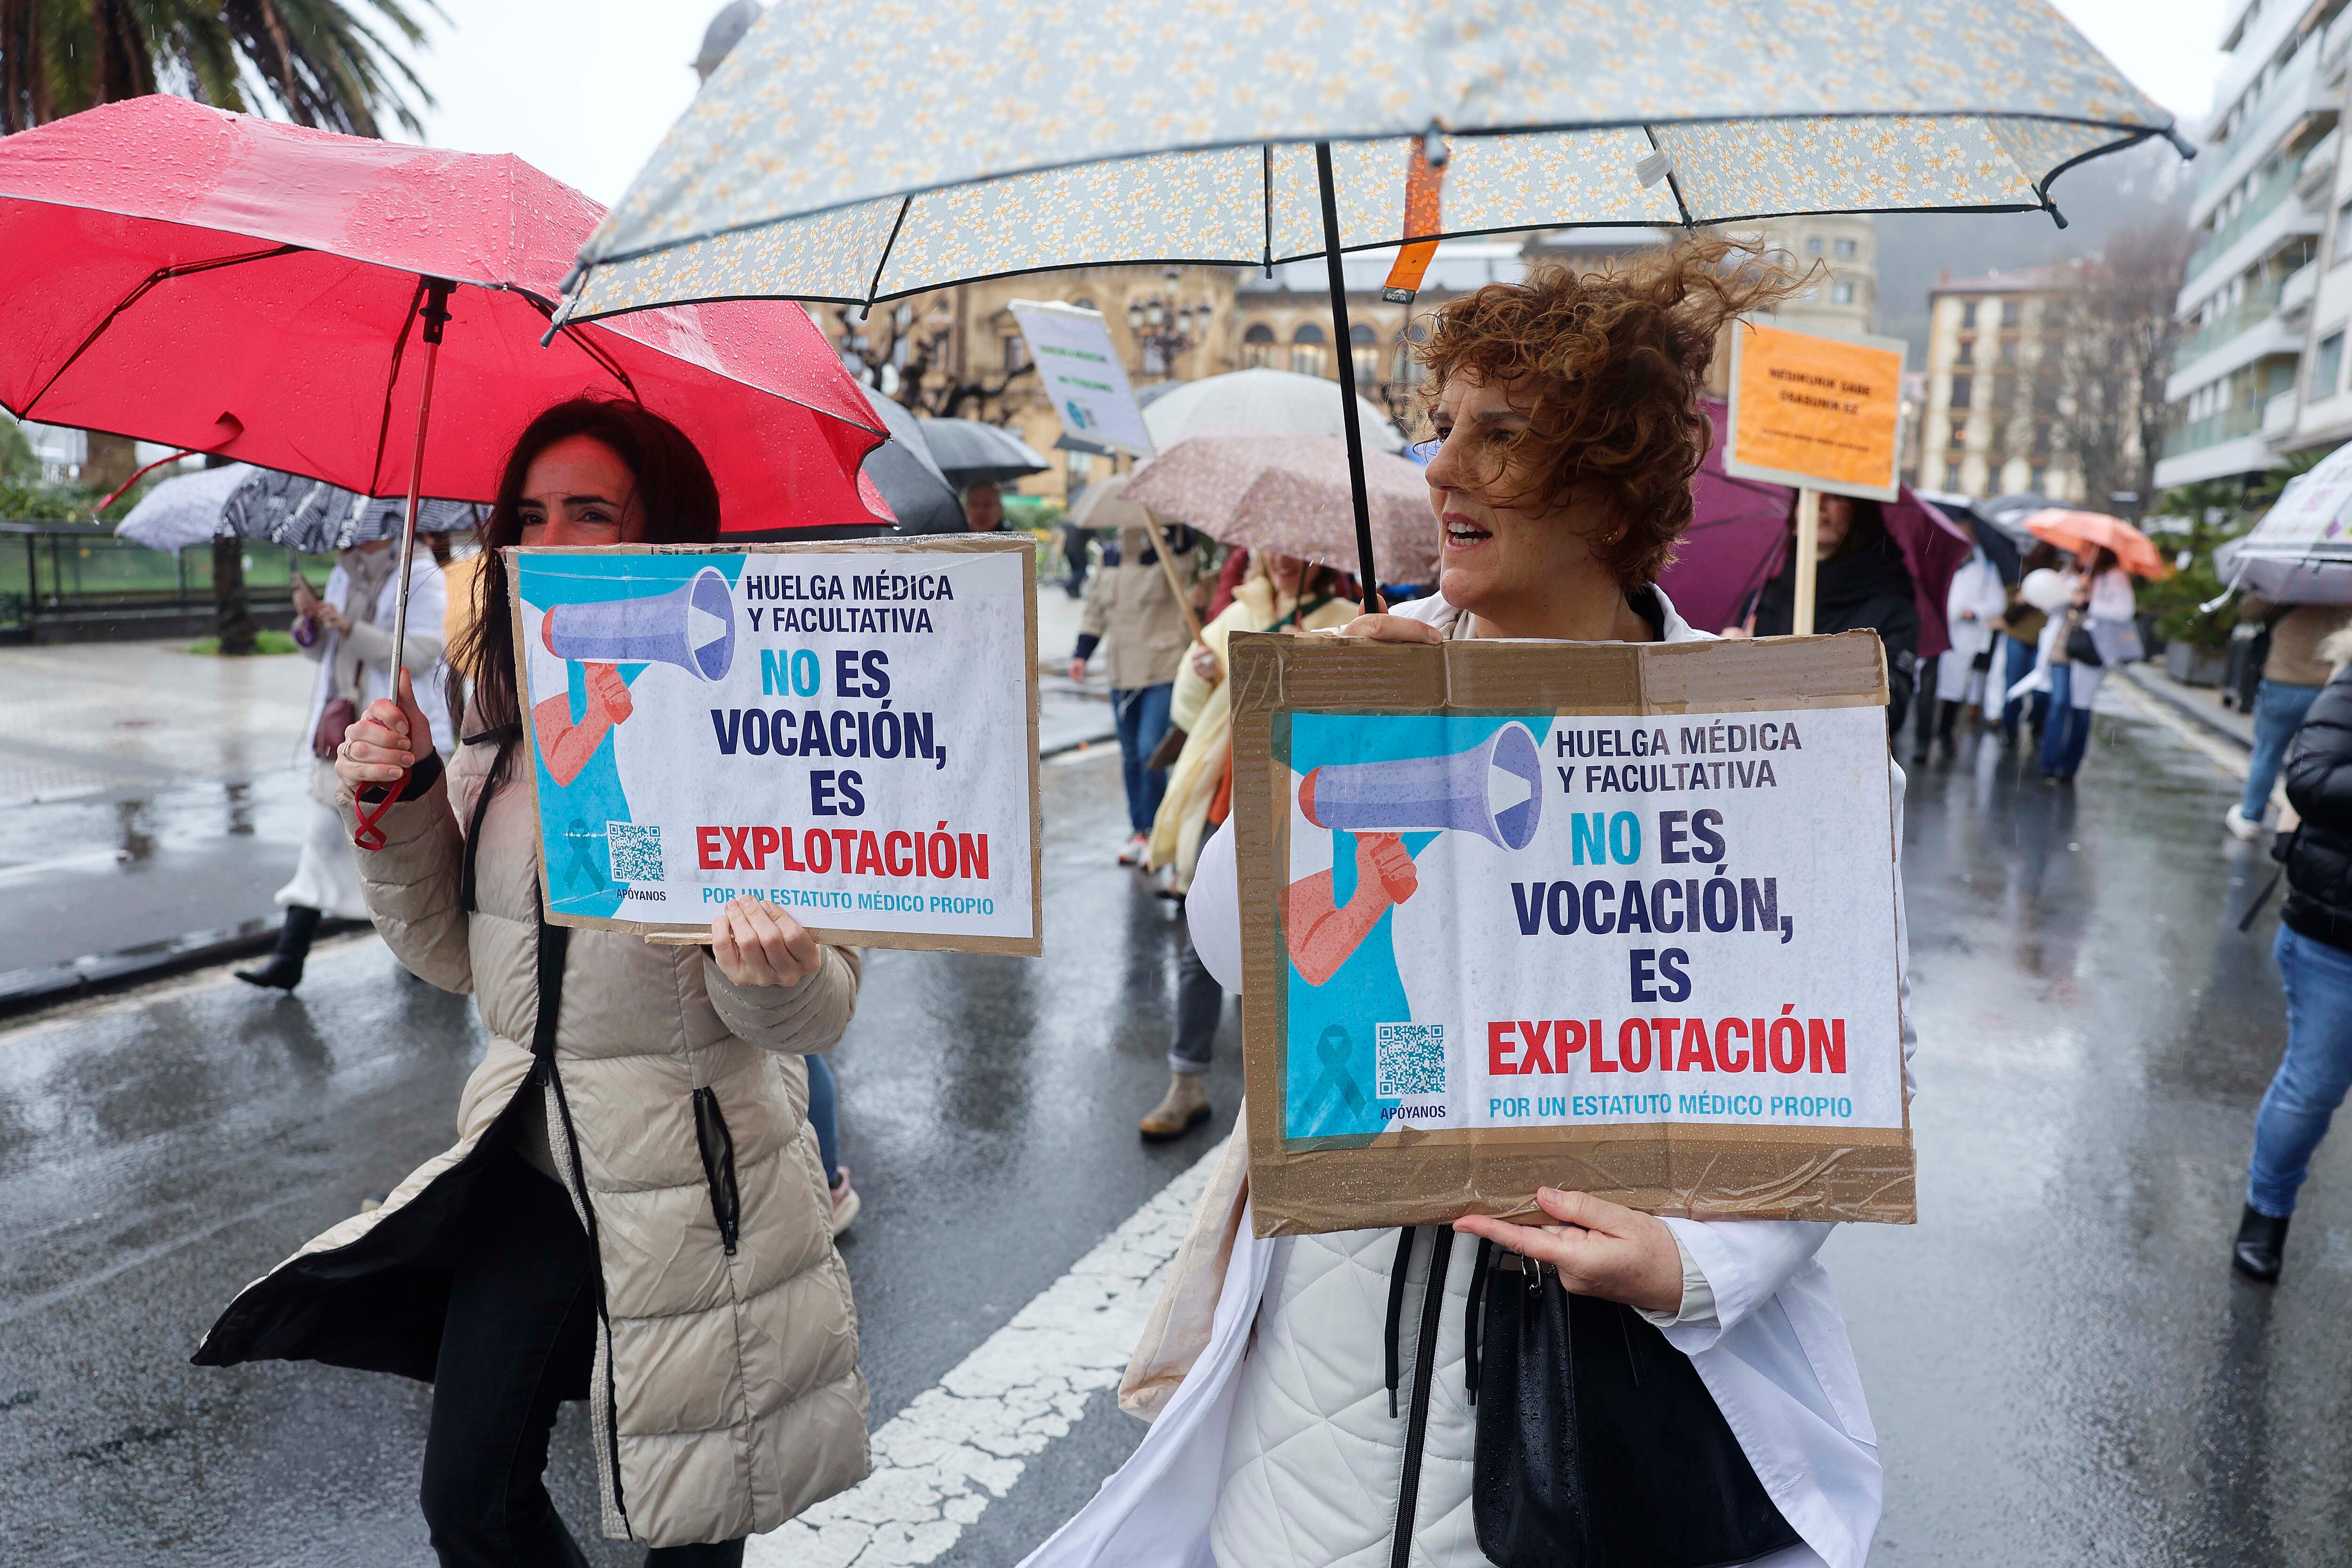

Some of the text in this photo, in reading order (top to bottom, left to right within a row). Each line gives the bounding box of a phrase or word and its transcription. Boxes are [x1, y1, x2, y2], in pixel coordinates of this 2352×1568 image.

[1386, 293, 1406, 302] GOTTA
[747, 569, 954, 600] HUELGA MÉDICA
[747, 608, 933, 633] Y FACULTATIVA
[761, 649, 892, 698] NO ES
[710, 700, 946, 771] VOCACIÓN,
[1557, 719, 1802, 757] HUELGA MÉDICA
[810, 770, 865, 816] ES
[1557, 760, 1777, 793] Y FACULTATIVA
[697, 821, 988, 879] EXPLOTACIÓN
[1571, 809, 1725, 866] NO ES
[617, 887, 666, 900] APÓYANOS
[703, 888, 735, 903] POR
[771, 889, 851, 908] ESTATUTO
[858, 891, 924, 912] MÉDICO
[930, 897, 993, 915] PROPIO
[1510, 864, 1793, 944] VOCACIÓN,
[1630, 948, 1691, 1003] ES
[1489, 1004, 1846, 1075] EXPLOTACIÓN
[1381, 1104, 1446, 1120] APÓYANOS
[1490, 1090, 1851, 1118] POR UN ESTATUTO MÉDICO PROPIO
